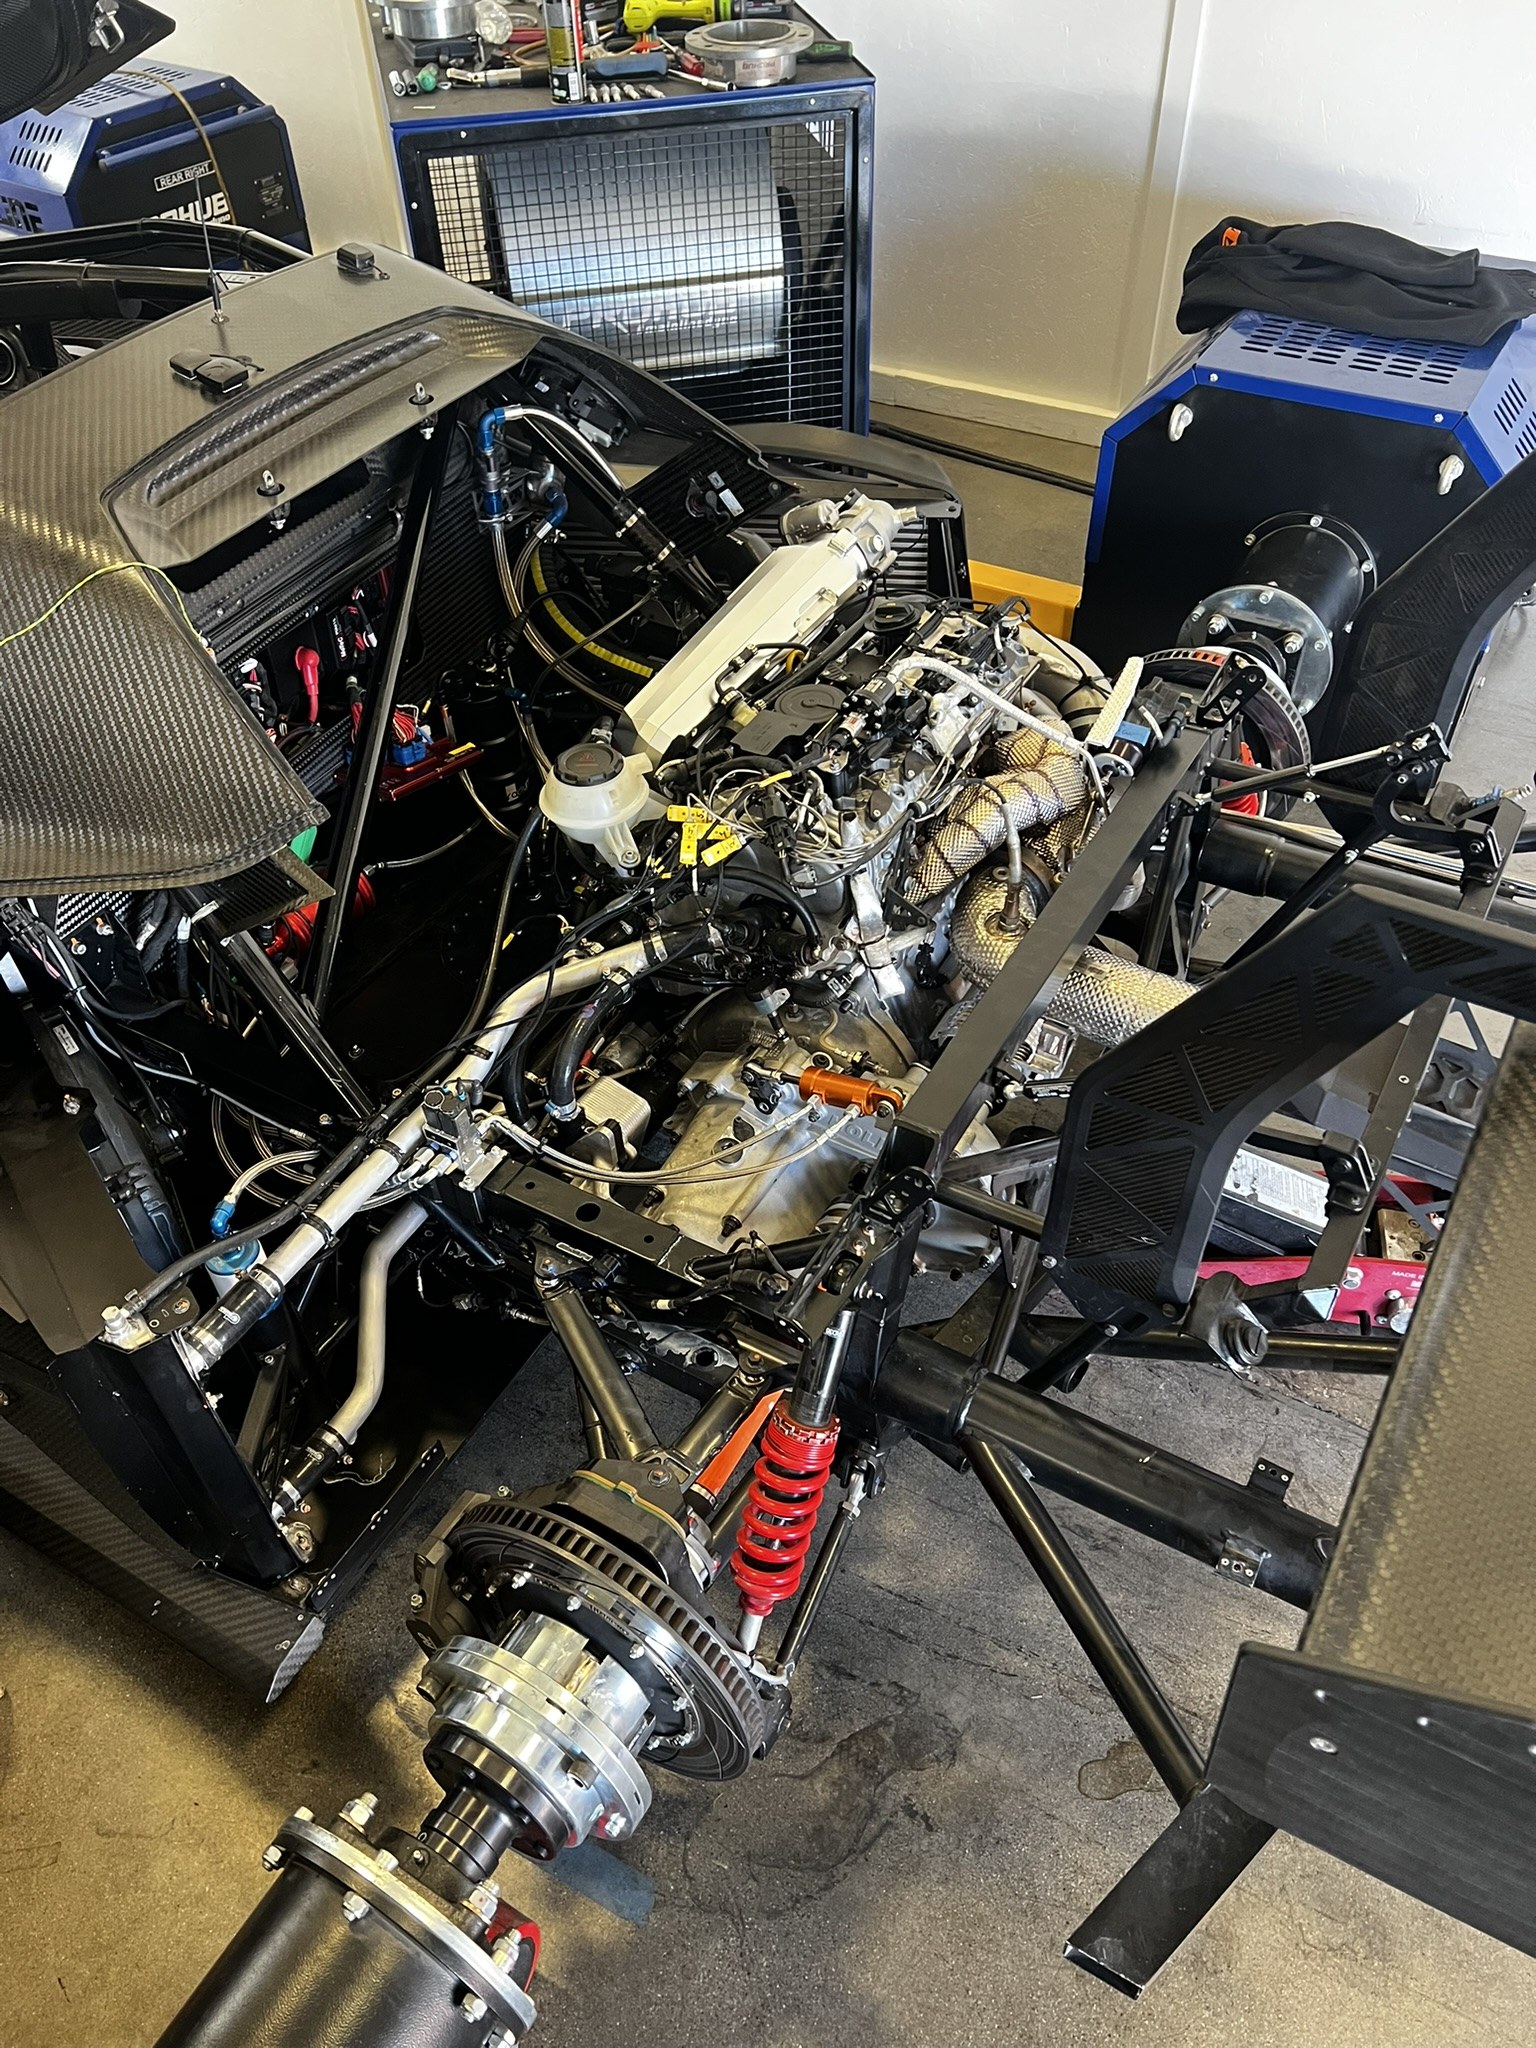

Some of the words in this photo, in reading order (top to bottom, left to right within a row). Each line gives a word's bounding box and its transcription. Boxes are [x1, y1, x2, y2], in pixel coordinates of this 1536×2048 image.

[160, 171, 184, 188] REAR
[184, 163, 211, 180] RIGHT
[1391, 1270, 1417, 1279] MADE
